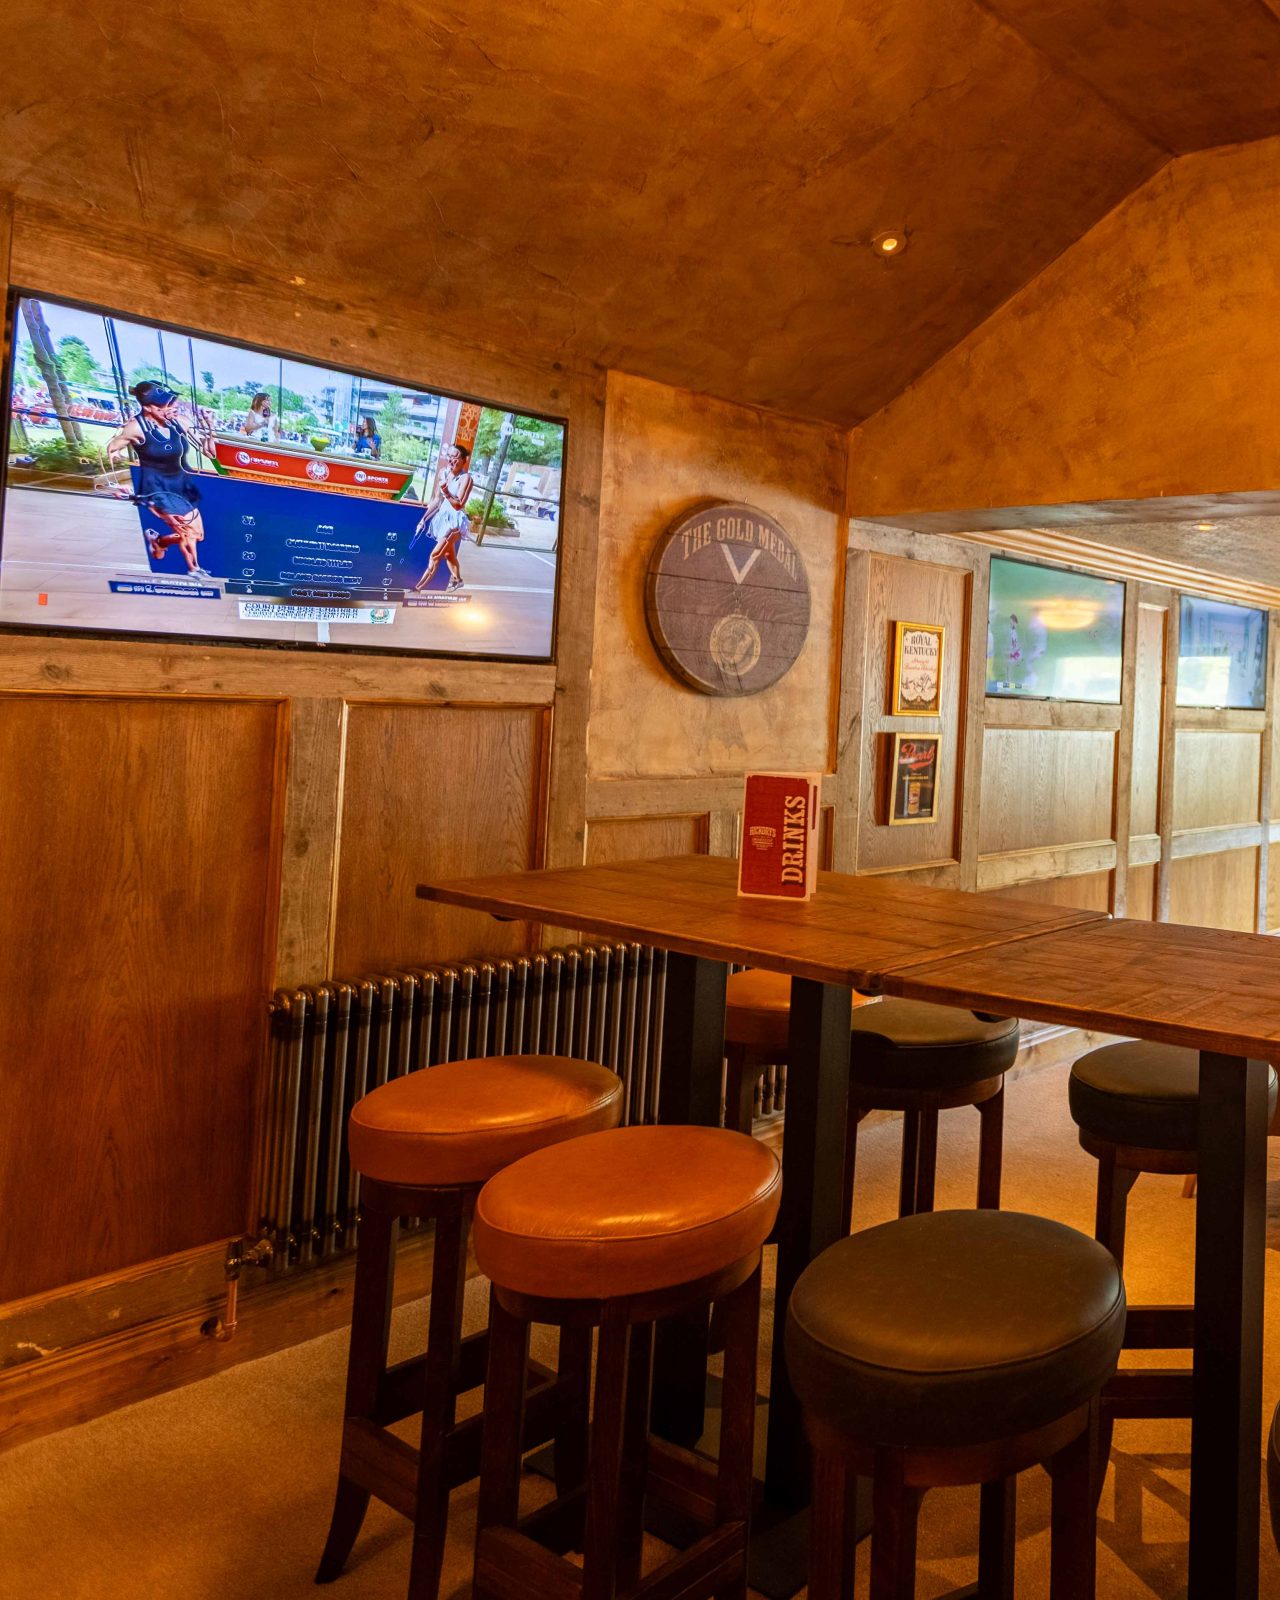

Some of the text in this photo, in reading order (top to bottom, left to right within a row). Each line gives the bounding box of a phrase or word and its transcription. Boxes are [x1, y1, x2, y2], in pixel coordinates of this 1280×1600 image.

[681, 516, 798, 583] THE GOLD MEDAL
[904, 645, 938, 657] KENTUCKY
[910, 634, 932, 647] ROYAL
[781, 795, 806, 885] DRINKS
